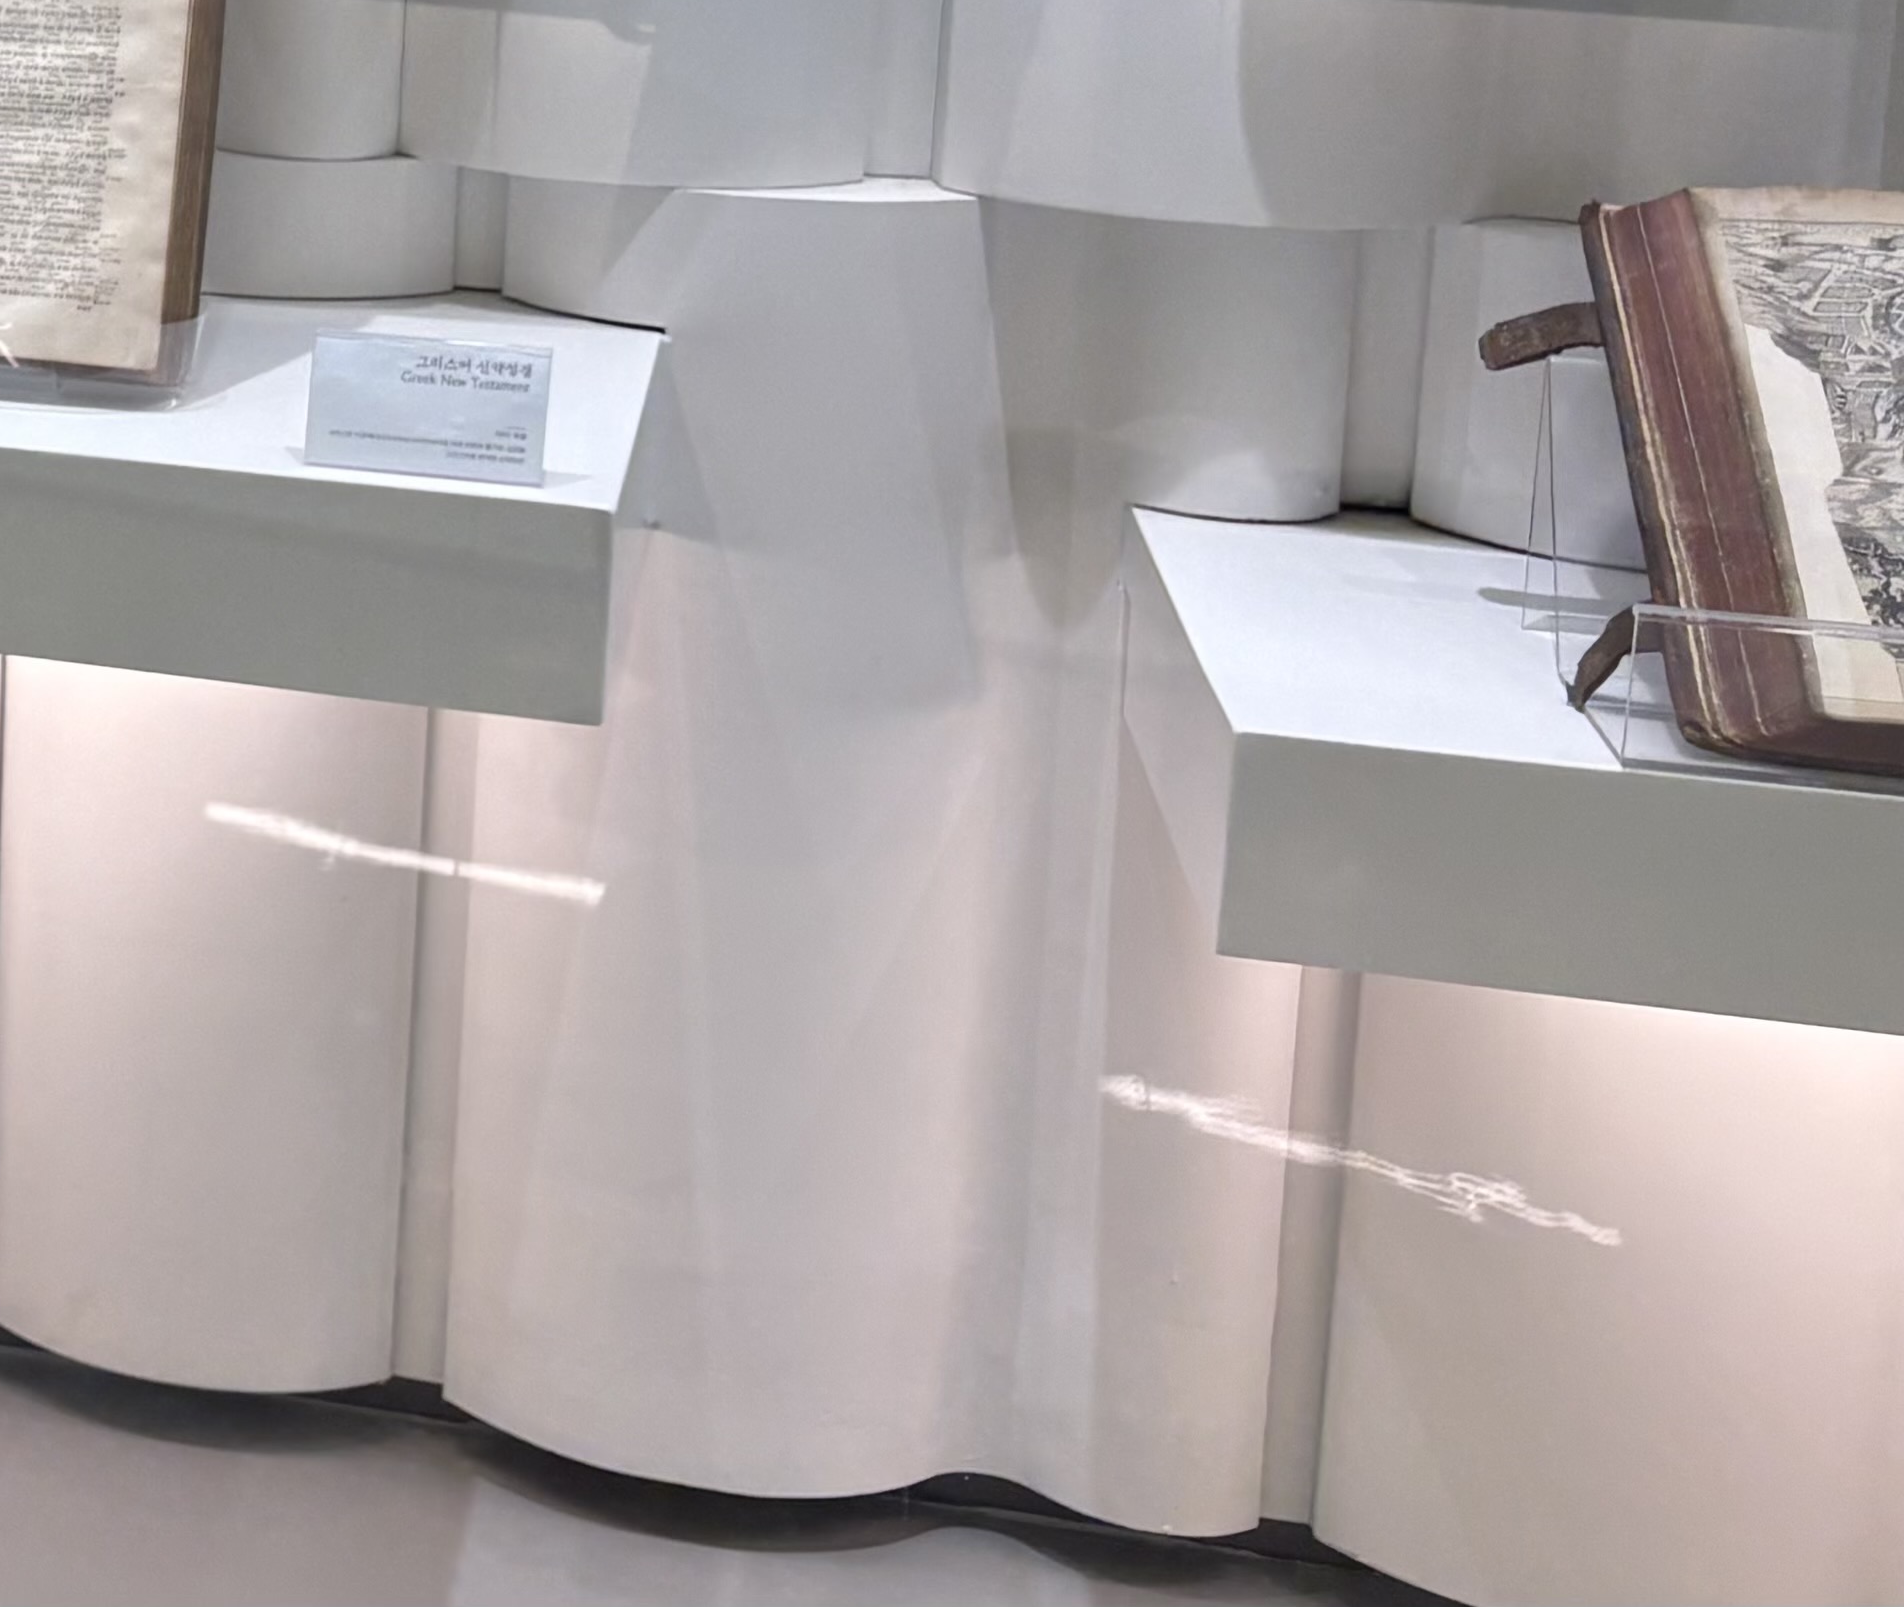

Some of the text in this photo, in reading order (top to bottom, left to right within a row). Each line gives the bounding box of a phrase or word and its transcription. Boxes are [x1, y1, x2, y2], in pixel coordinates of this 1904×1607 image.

[401, 371, 531, 393] Greek New Testament
